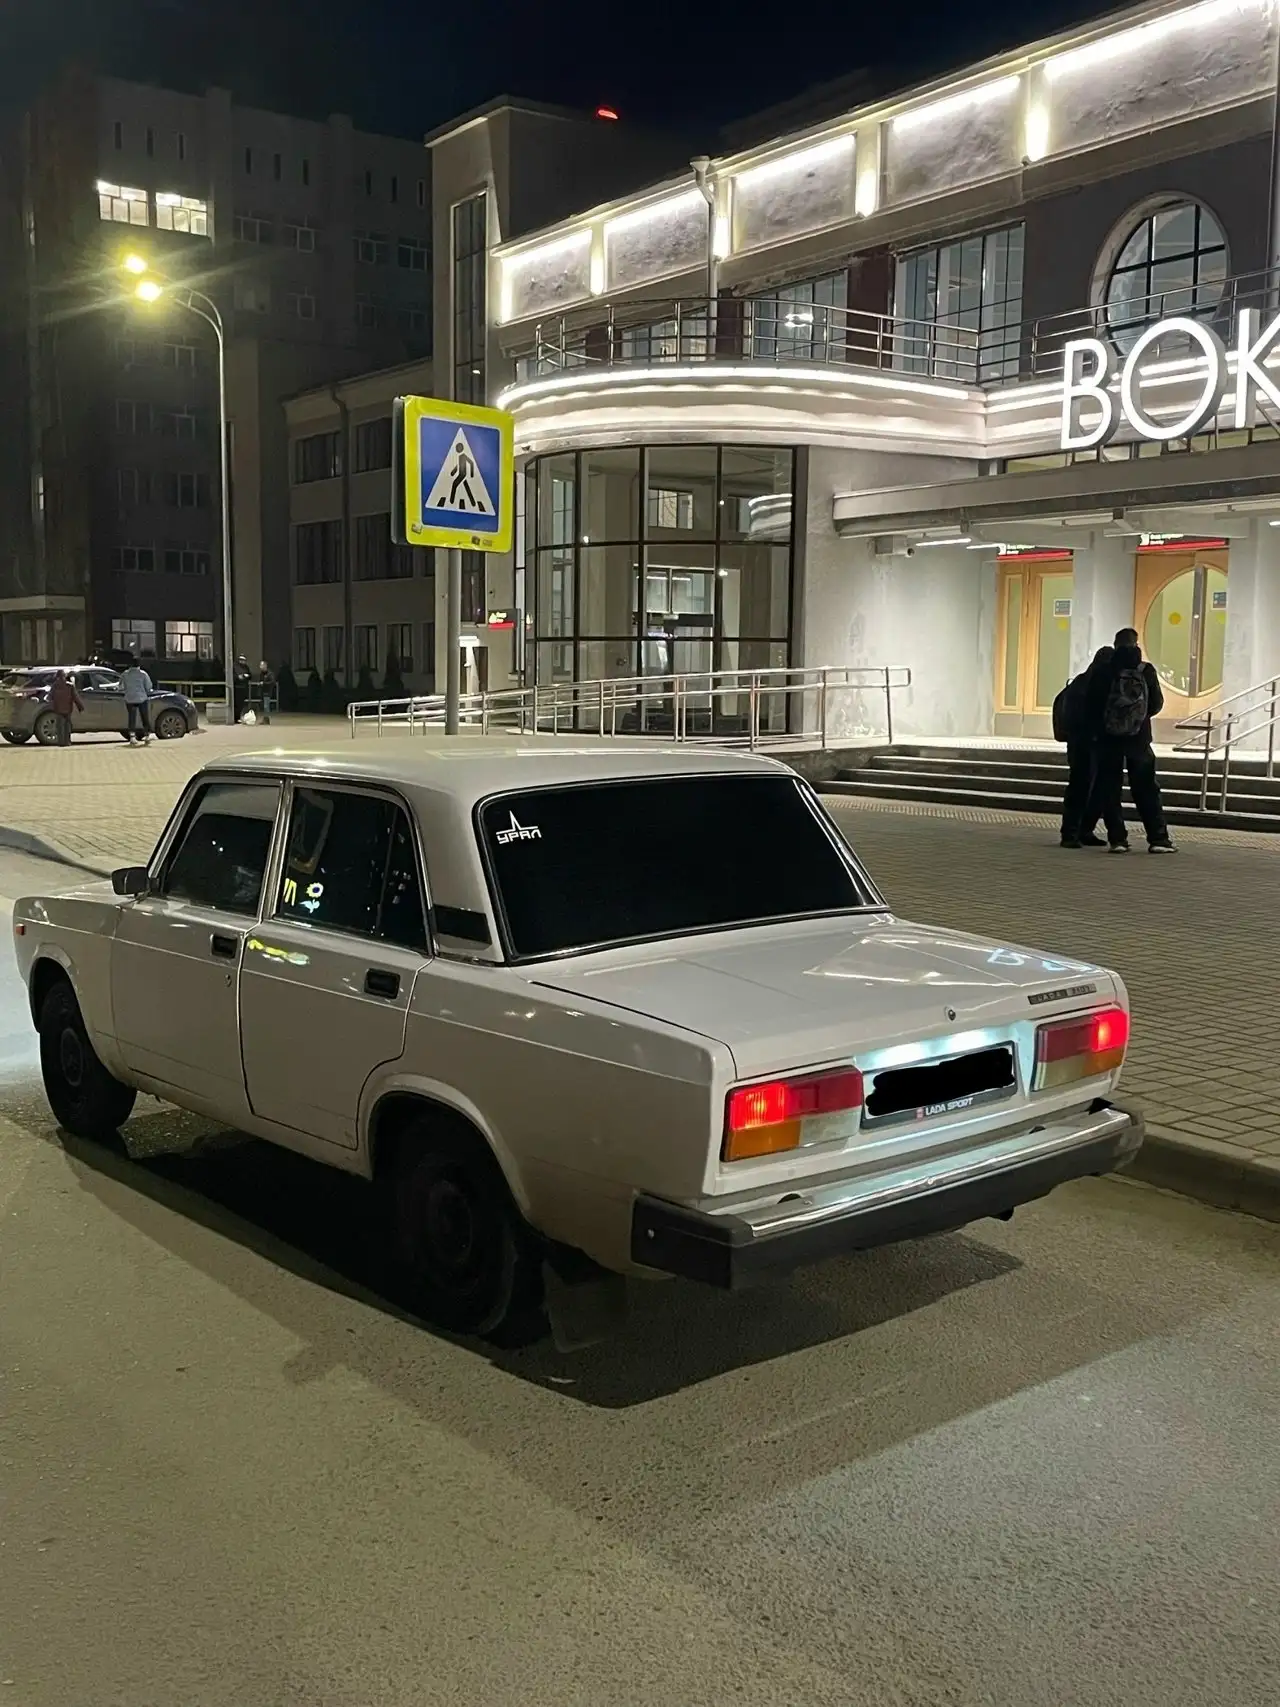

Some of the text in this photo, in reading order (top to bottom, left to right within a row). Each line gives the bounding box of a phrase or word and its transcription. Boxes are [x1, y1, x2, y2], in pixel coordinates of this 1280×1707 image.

[496, 829, 542, 845] УРАЛ
[925, 1097, 974, 1116] LADA SPORT
